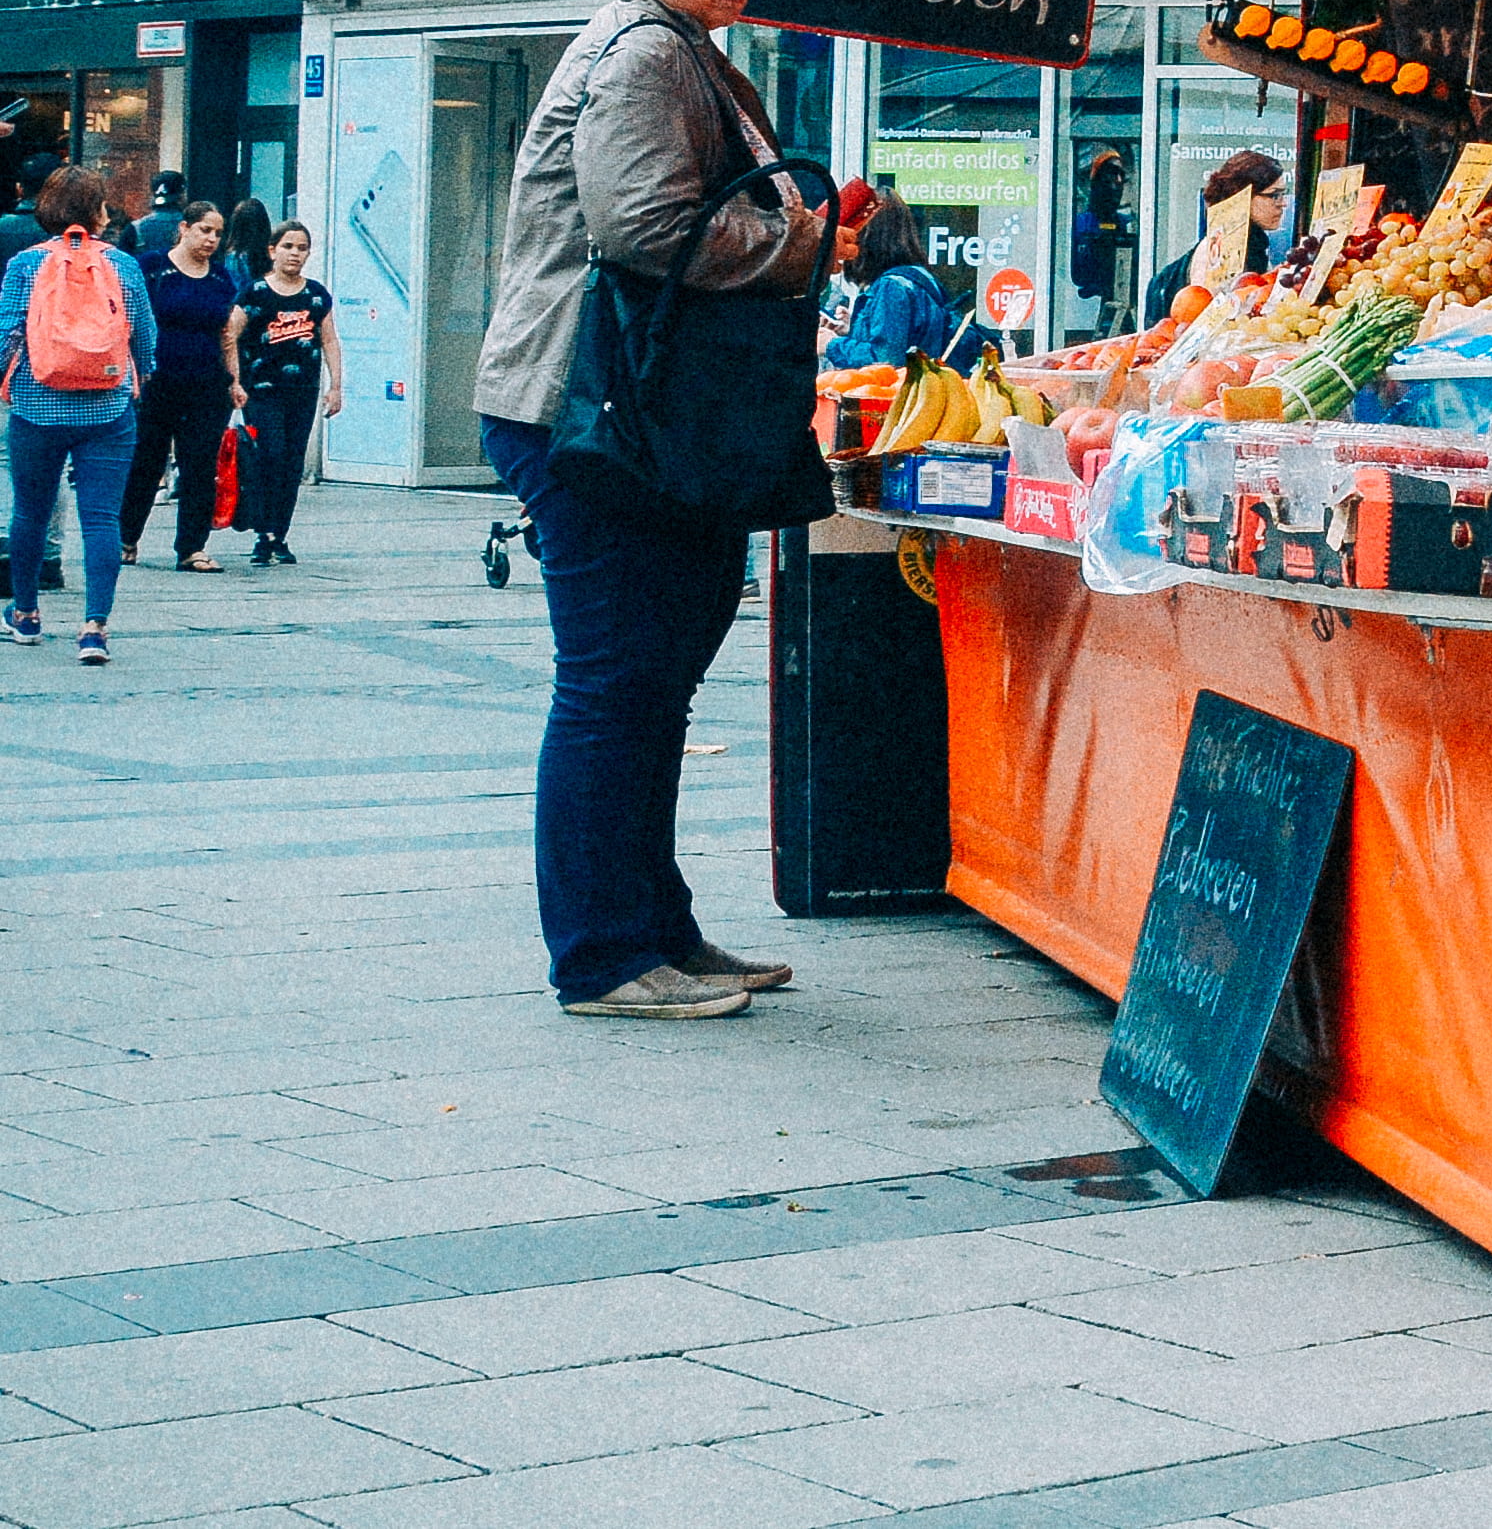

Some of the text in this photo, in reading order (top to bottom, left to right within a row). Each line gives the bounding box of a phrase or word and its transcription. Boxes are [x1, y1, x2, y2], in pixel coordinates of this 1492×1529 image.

[873, 149, 946, 169] Einfach
[953, 150, 1020, 170] endlos
[928, 226, 1012, 266] Free
